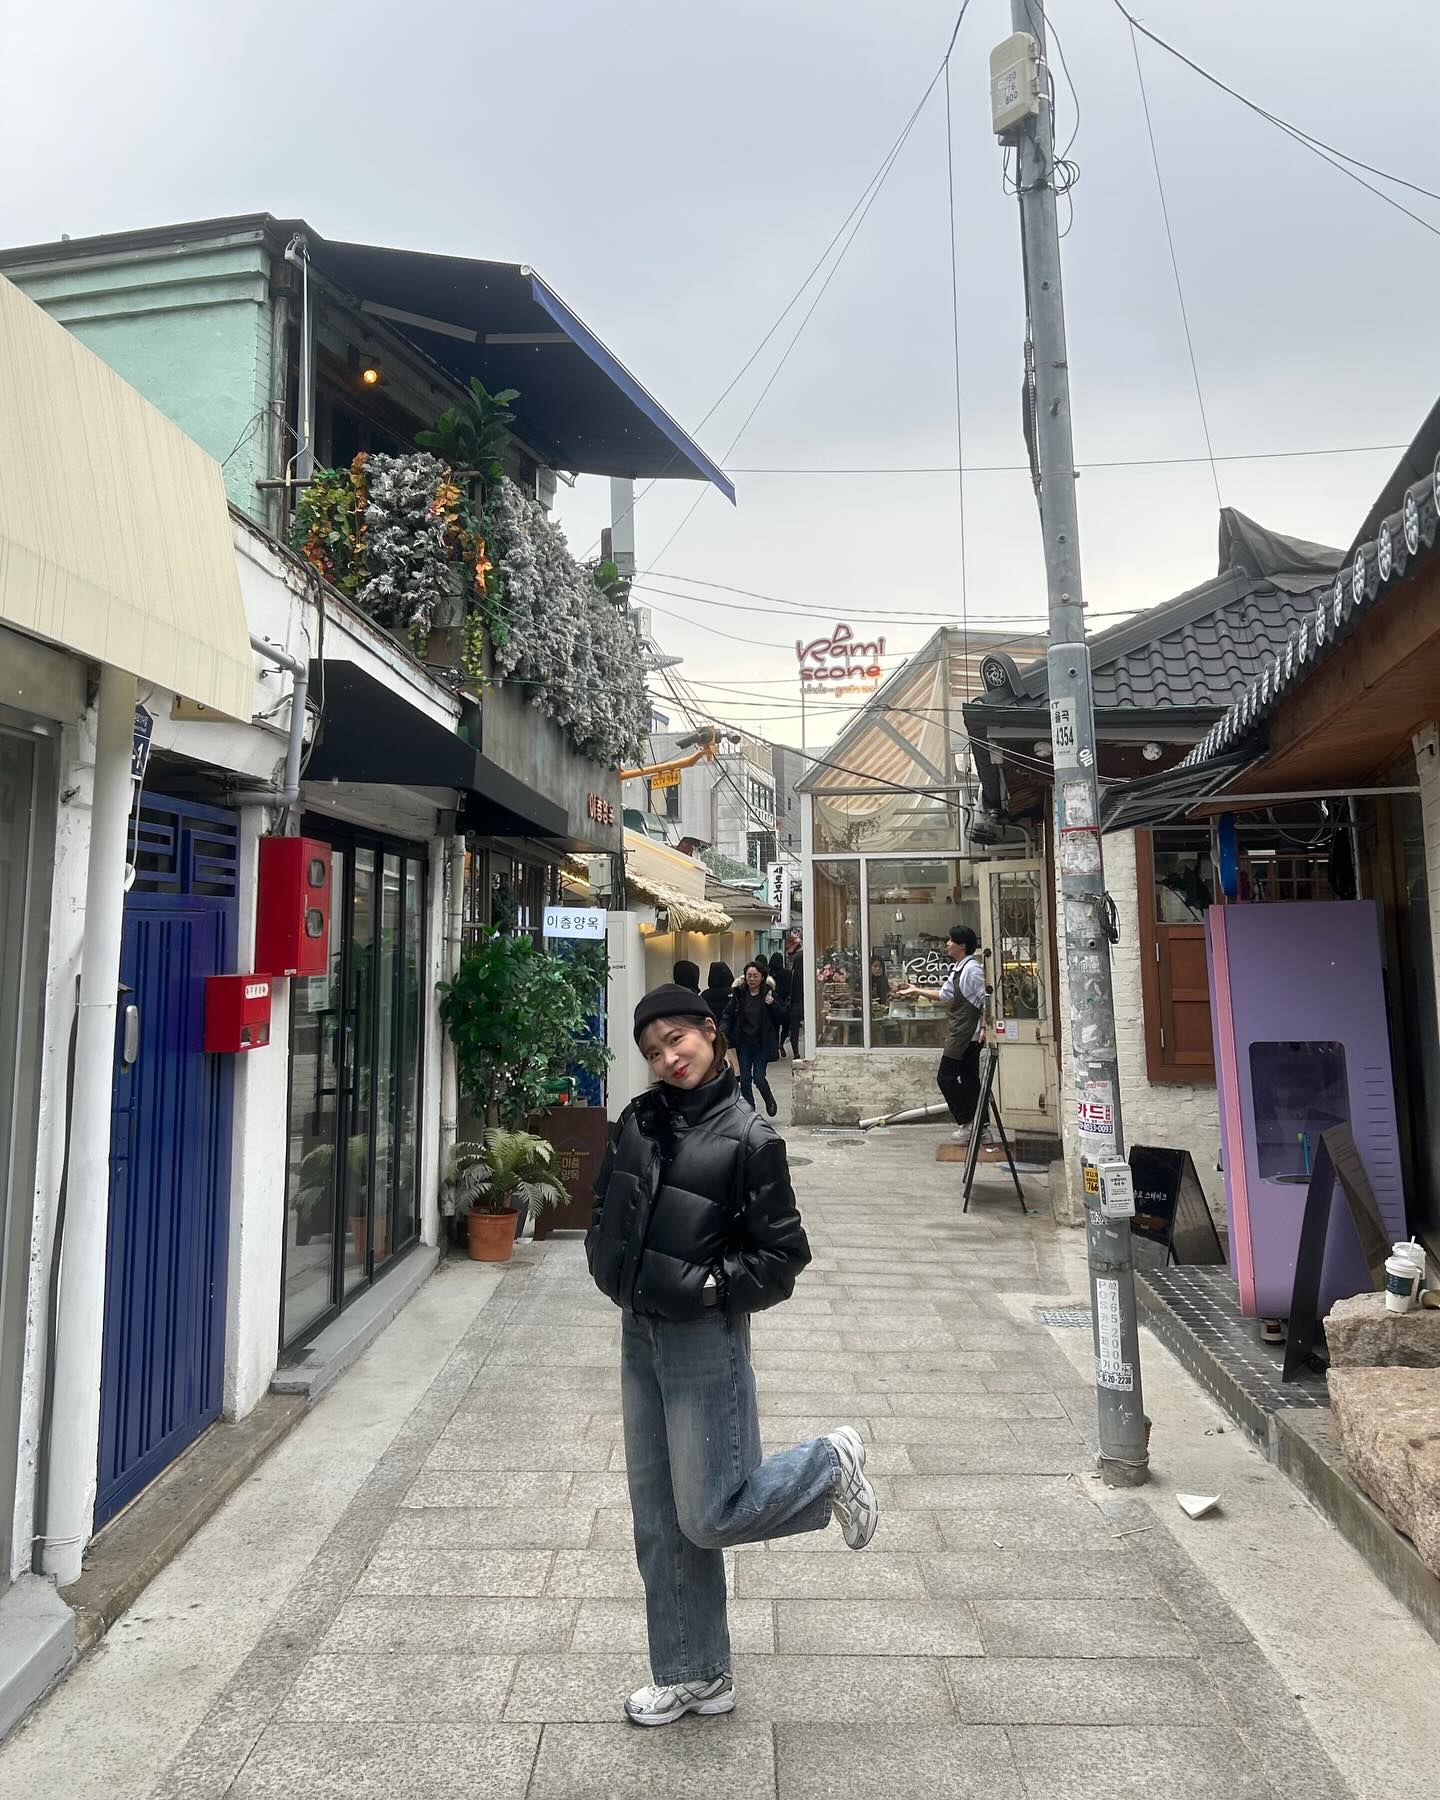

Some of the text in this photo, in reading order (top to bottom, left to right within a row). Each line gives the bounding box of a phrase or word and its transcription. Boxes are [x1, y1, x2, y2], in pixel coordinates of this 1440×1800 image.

[800, 666, 881, 680] scone
[547, 915, 599, 931] 이층양옥
[902, 957, 956, 972] Ram
[908, 974, 950, 984] scon
